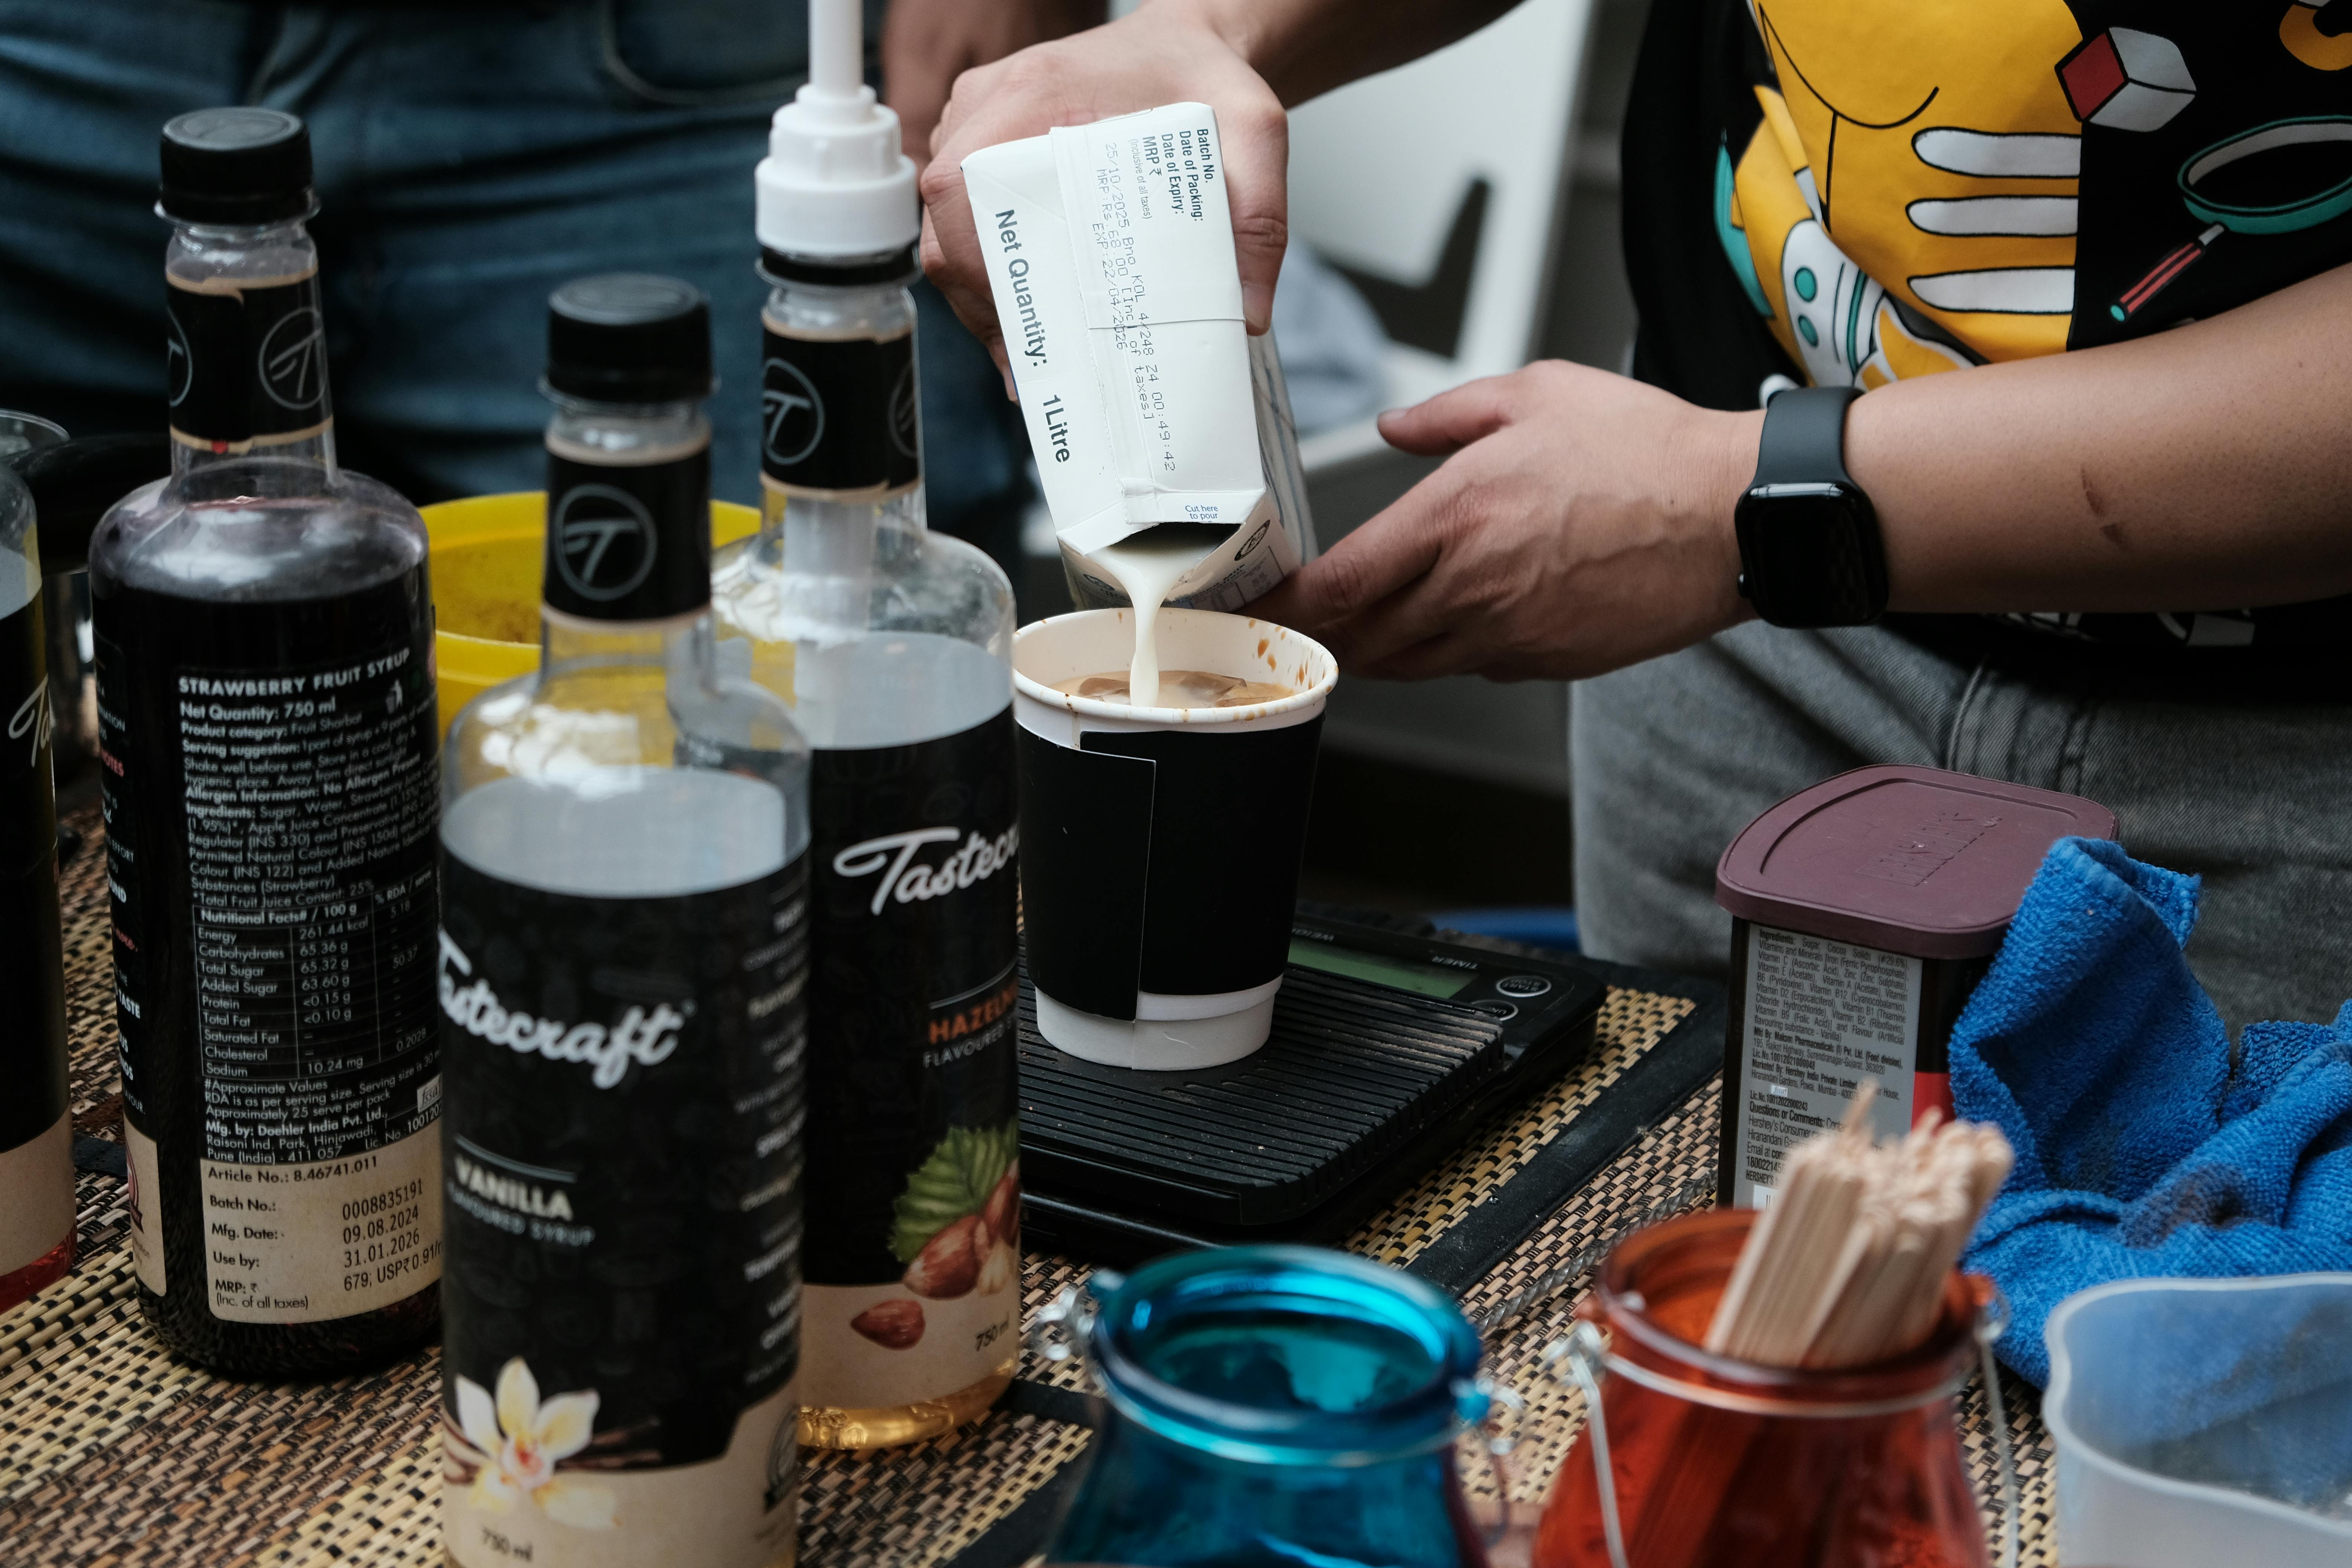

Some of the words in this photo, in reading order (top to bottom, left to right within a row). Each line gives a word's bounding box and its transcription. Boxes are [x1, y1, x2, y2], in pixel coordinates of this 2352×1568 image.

[1128, 139, 1142, 174] (Inclusive
[1143, 136, 1159, 164] MRP
[1162, 133, 1175, 158] Date
[1179, 131, 1192, 156] Date
[1197, 129, 1212, 160] Batch
[1149, 168, 1162, 176] ₹
[1167, 162, 1179, 172] of
[1185, 160, 1197, 170] of
[1203, 165, 1215, 183] No.
[1139, 185, 1148, 194] all
[1169, 176, 1184, 214] Expiry:
[1187, 175, 1203, 222] Packing:
[1141, 196, 1152, 219] taxes)
[995, 209, 1022, 253] Net
[1008, 258, 1047, 367] Quantity:
[1106, 142, 1130, 228] 25/10/2025
[1131, 275, 1145, 303] KOL
[1152, 392, 1175, 471] 00:49:42
[1130, 341, 1141, 356] of
[1134, 366, 1155, 419] taxes]
[179, 676, 306, 697] STRAWBERRY
[313, 665, 361, 691] FRUIT
[367, 647, 410, 678] SYRUP
[180, 700, 206, 719] Net
[208, 703, 279, 724] Quantity:
[284, 700, 314, 719] 750
[318, 694, 336, 715] ml
[200, 908, 265, 925] Nutritional
[324, 903, 346, 919] 100
[349, 902, 357, 917] g
[198, 927, 237, 945] Energy
[299, 923, 344, 940] 261.44
[347, 916, 369, 932] kcal
[198, 944, 285, 962] Carbohydrates
[300, 942, 337, 957] 65.36
[340, 940, 348, 954] g
[1759, 928, 1796, 945] Ingredients:
[1828, 943, 1847, 956] Cocoa
[1853, 948, 1871, 961] Solids
[200, 961, 226, 975] Total
[230, 963, 265, 980] Sugar
[300, 957, 337, 974] 65.32
[341, 957, 349, 971] g
[1431, 956, 1478, 970] TIMER
[1759, 950, 1780, 963] Vitamin
[1784, 956, 1788, 965] C
[1792, 958, 1821, 972] (Ascorbic
[1844, 968, 1857, 980] Zinc
[1861, 971, 1875, 983] (Zinc
[201, 977, 239, 993] Added
[243, 981, 278, 997] Sugar
[301, 975, 339, 991] 63.60
[341, 974, 350, 988] g
[1758, 961, 1779, 974] Vitamin
[1782, 966, 1786, 976] E
[1823, 974, 1845, 988] Vitamin
[1847, 980, 1851, 989] A
[1885, 988, 1908, 1002] Vitamin
[118, 987, 140, 1019] TASTE
[202, 994, 240, 1010] Protein
[343, 992, 351, 1005] g
[202, 1011, 230, 1026] Total
[233, 1015, 251, 1027] Fat
[343, 1008, 352, 1021] g
[1752, 1058, 1774, 1072] Marketed
[1786, 1066, 1805, 1079] Hershey
[1807, 1070, 1819, 1082] India
[1821, 1073, 1838, 1086] Private
[206, 1119, 231, 1137] Mfg.
[235, 1122, 254, 1138] by:
[257, 1121, 305, 1137] Doehler
[309, 1119, 339, 1133] India
[342, 1115, 362, 1128] Pvt.
[1749, 1115, 1778, 1132] Hershey's
[1780, 1121, 1811, 1138] Consumer
[1750, 1101, 1780, 1118] Questions
[1782, 1110, 1787, 1119] or
[1790, 1110, 1825, 1128] Comments:
[207, 1134, 247, 1148] Raisoni
[252, 1138, 274, 1150] Ind.
[279, 1135, 309, 1150] Park,
[314, 1124, 377, 1146] Hinjawadi,
[208, 1166, 253, 1184] Article
[257, 1170, 289, 1184] No.:
[293, 1156, 378, 1183] 8.46741.011
[1746, 1170, 1774, 1185] HERSHEY'S
[210, 1195, 244, 1211] Batch
[247, 1196, 277, 1212] No.:
[342, 1178, 423, 1220] 0008835191
[455, 1154, 574, 1222] VANILLA
[211, 1223, 240, 1241] Mfg.
[244, 1227, 278, 1240] Date:
[343, 1205, 420, 1244] 09.08.2024
[213, 1251, 236, 1266] Use
[239, 1253, 260, 1271] by:
[343, 1228, 420, 1268] 31.01.2026
[215, 1279, 246, 1294] MRP:
[343, 1271, 372, 1292] 679;
[217, 1296, 239, 1308] (Inc.
[242, 1296, 255, 1308] of
[257, 1296, 271, 1309] all
[274, 1296, 309, 1311] taxes)
